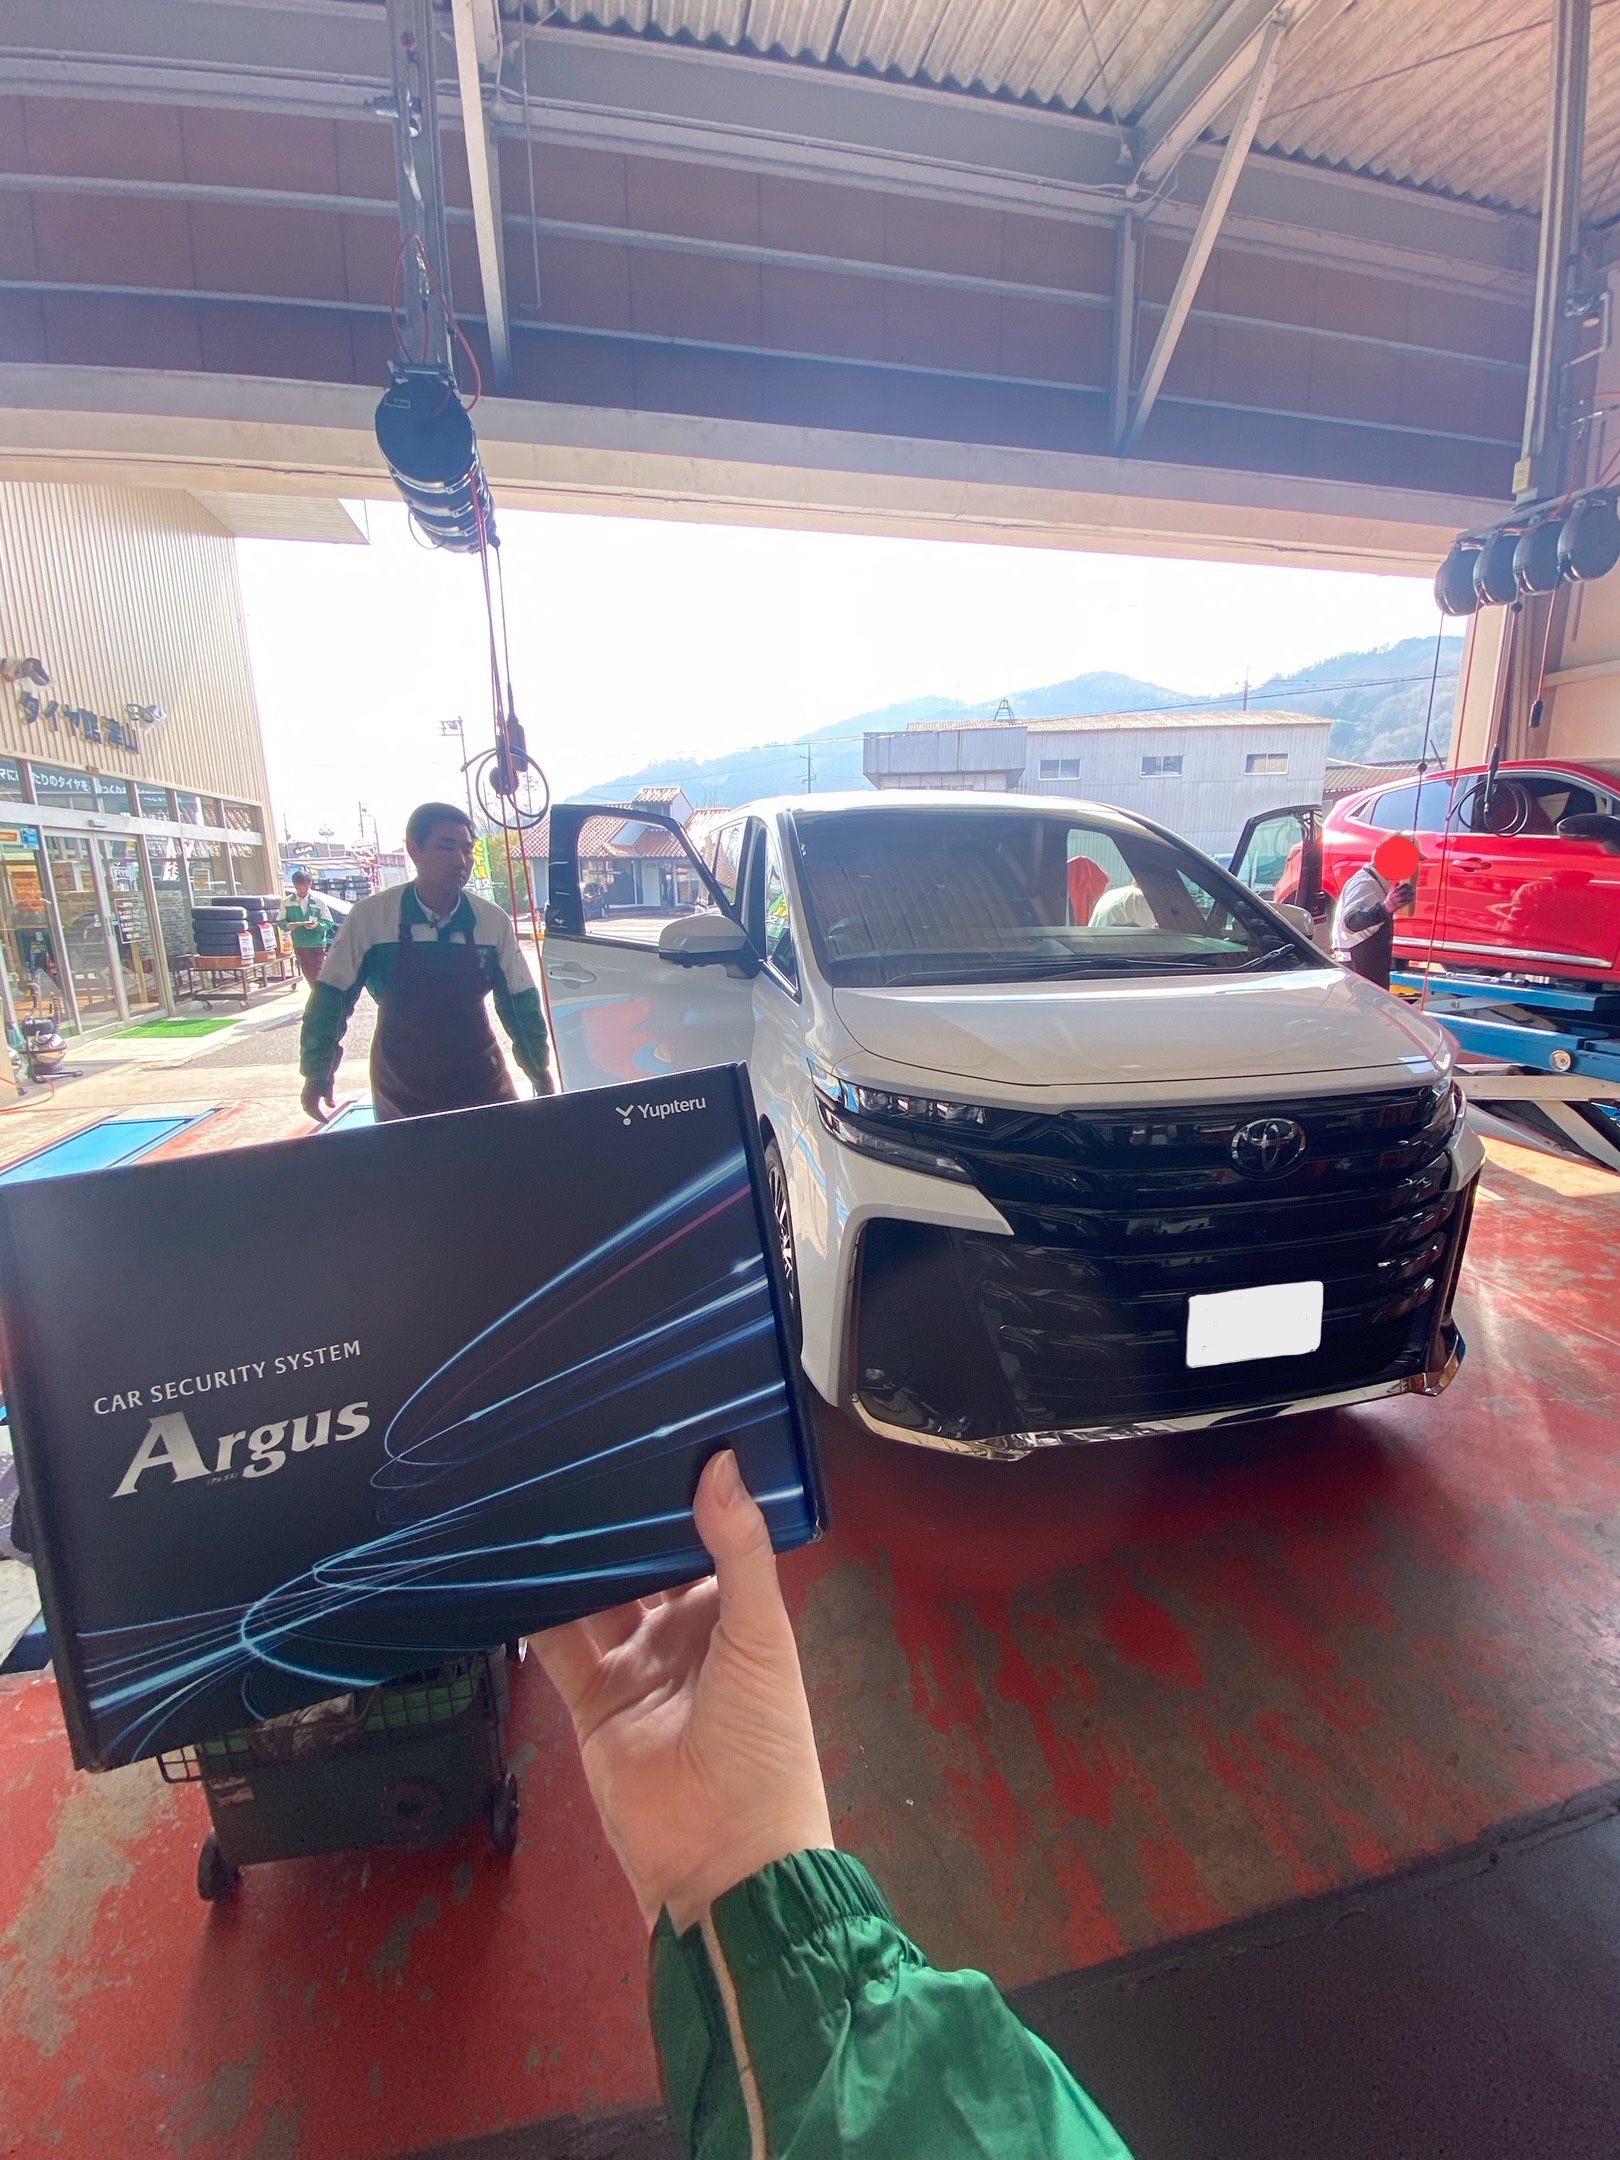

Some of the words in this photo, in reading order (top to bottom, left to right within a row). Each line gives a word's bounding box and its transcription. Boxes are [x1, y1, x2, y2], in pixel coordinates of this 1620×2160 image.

[637, 1097, 707, 1120] Yupiteru
[93, 1390, 143, 1415] CAR
[151, 1361, 266, 1403] SECURITY
[274, 1339, 361, 1375] SYSTEM
[110, 1401, 371, 1498] Argus
